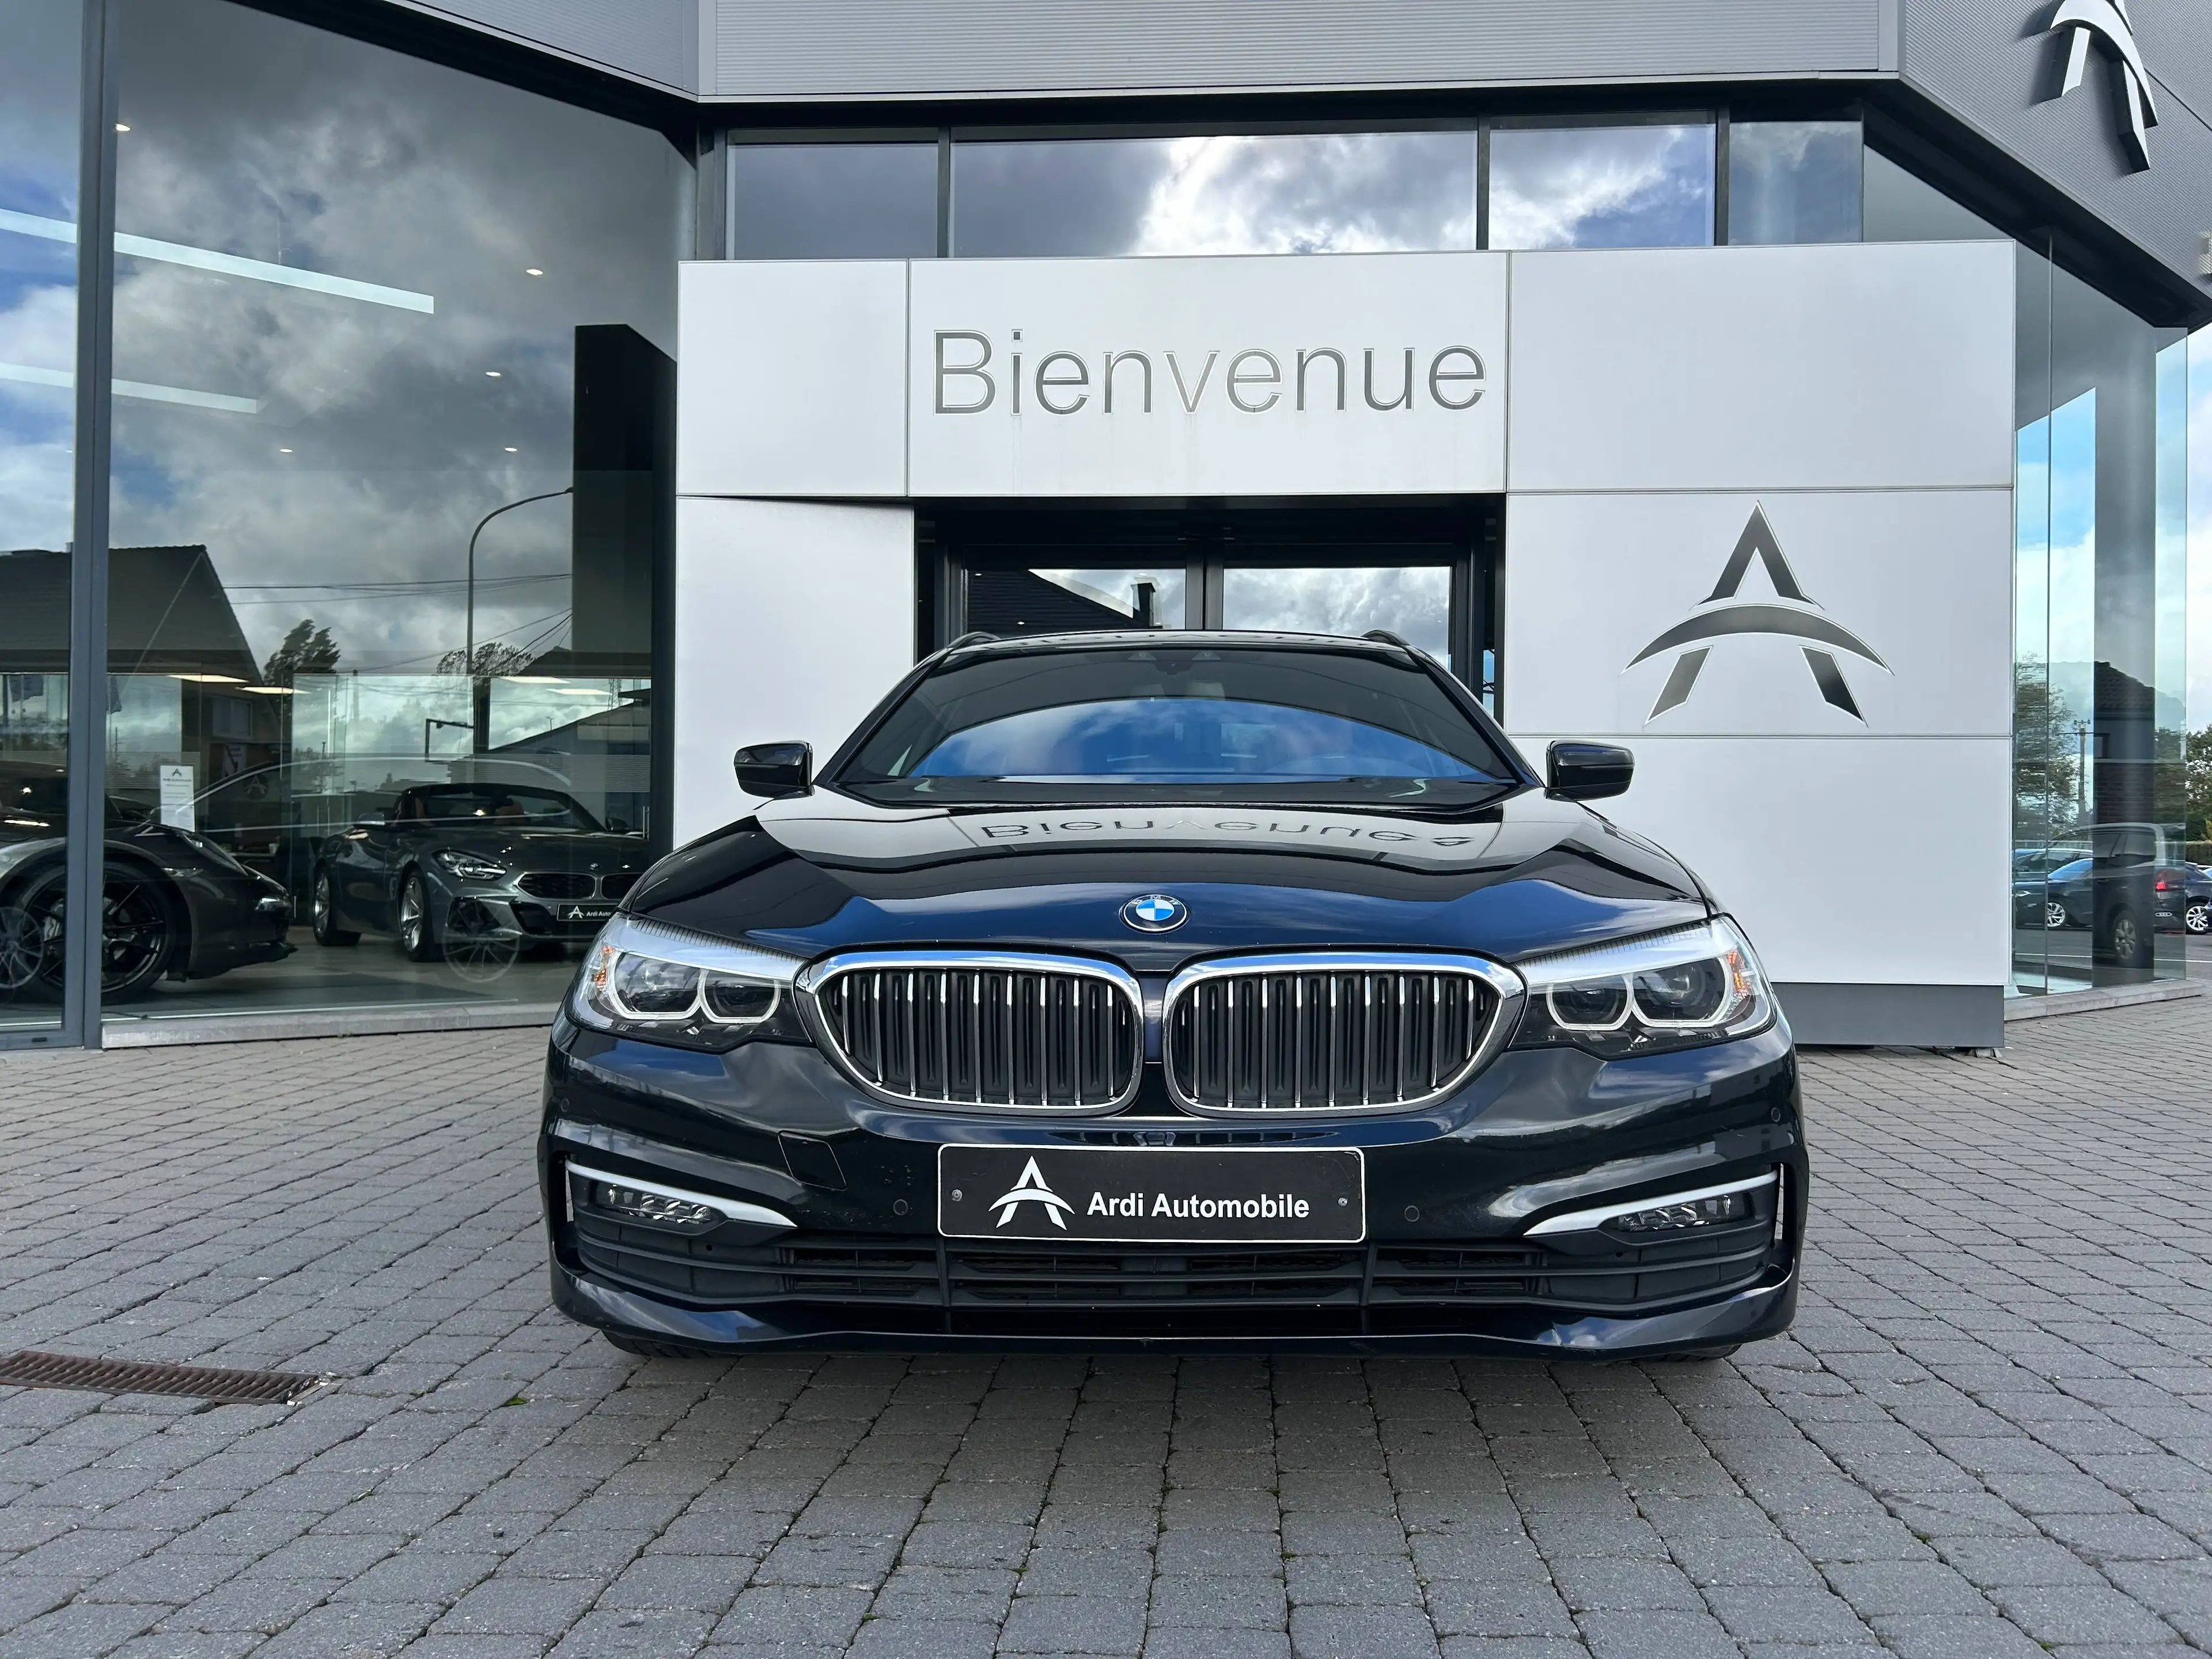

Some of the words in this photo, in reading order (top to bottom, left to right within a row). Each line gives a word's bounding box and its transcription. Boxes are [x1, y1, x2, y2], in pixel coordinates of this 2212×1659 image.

[933, 328, 1486, 416] Bienvenue
[1087, 1192, 1143, 1217] Ardi
[1152, 1193, 1309, 1218] Automobile
